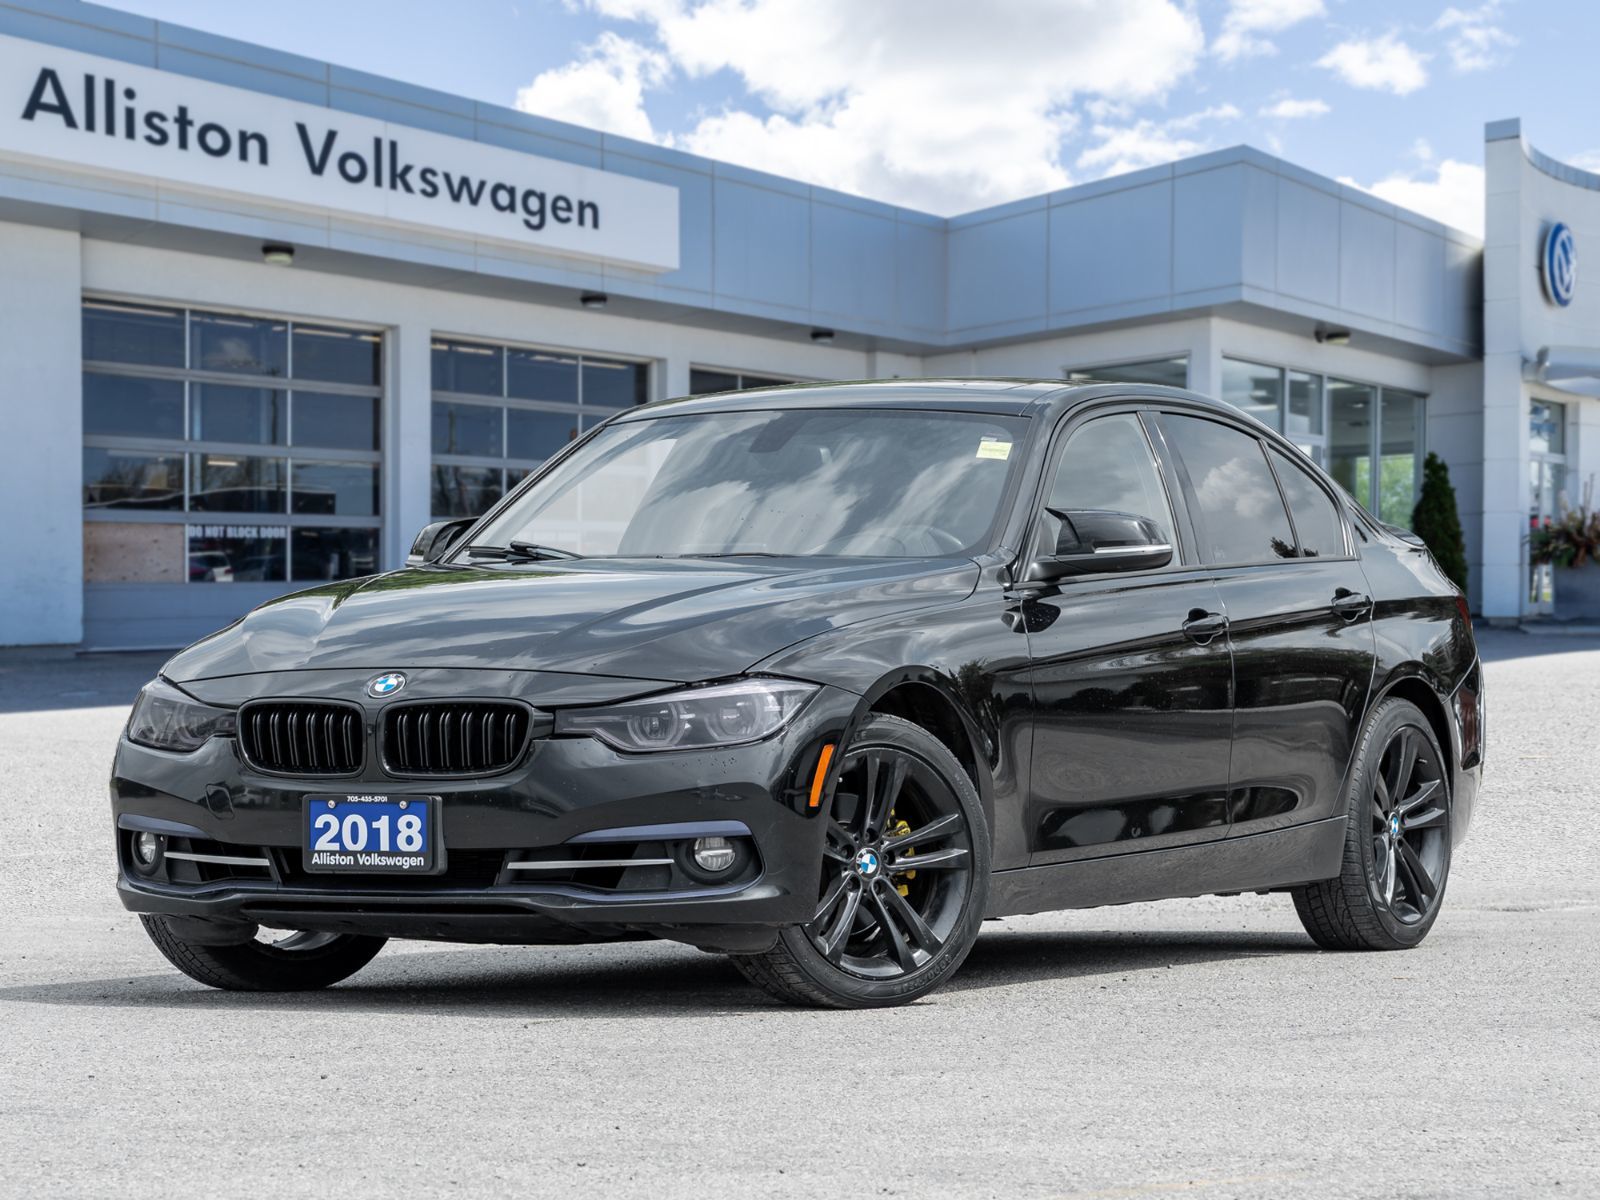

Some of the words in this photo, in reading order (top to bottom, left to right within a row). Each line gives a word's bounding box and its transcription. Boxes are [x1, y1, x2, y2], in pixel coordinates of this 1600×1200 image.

[20, 66, 270, 167] Alliston
[295, 121, 601, 232] Volkswagen
[189, 526, 203, 538] DO
[205, 526, 225, 538] NOT
[226, 526, 259, 538] BLOCK
[260, 527, 287, 539] DOOR
[314, 813, 423, 852] 2018
[311, 853, 354, 865] Alliston
[357, 854, 425, 869] Volkswagen
